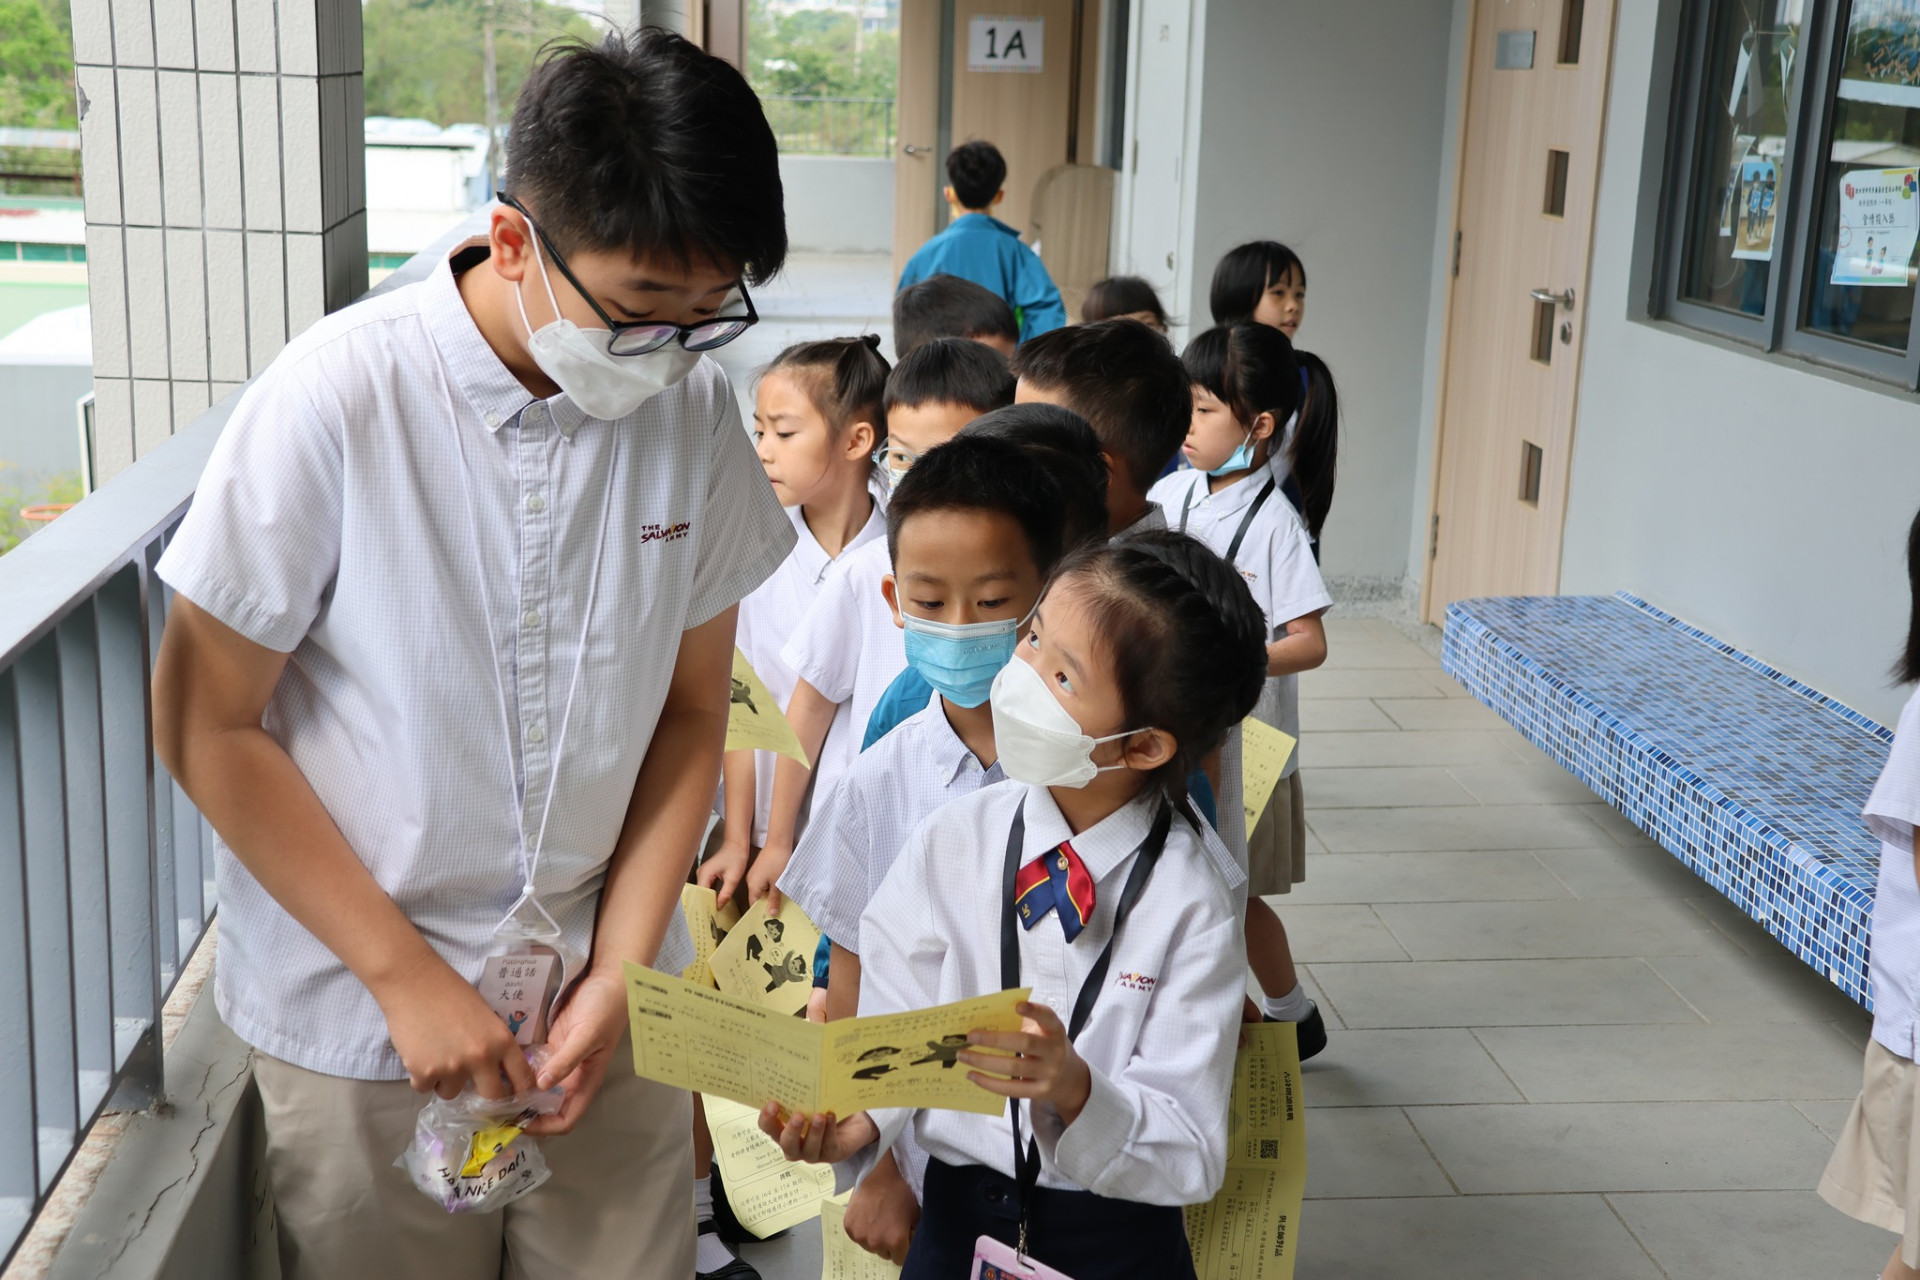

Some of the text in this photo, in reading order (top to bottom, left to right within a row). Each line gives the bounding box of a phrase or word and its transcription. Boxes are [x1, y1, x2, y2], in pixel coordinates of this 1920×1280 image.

[985, 27, 1026, 59] 1A
[665, 532, 688, 543] ARMY
[498, 967, 537, 979] 普通話
[1121, 981, 1152, 992] ARMY
[499, 989, 524, 1001] 大使
